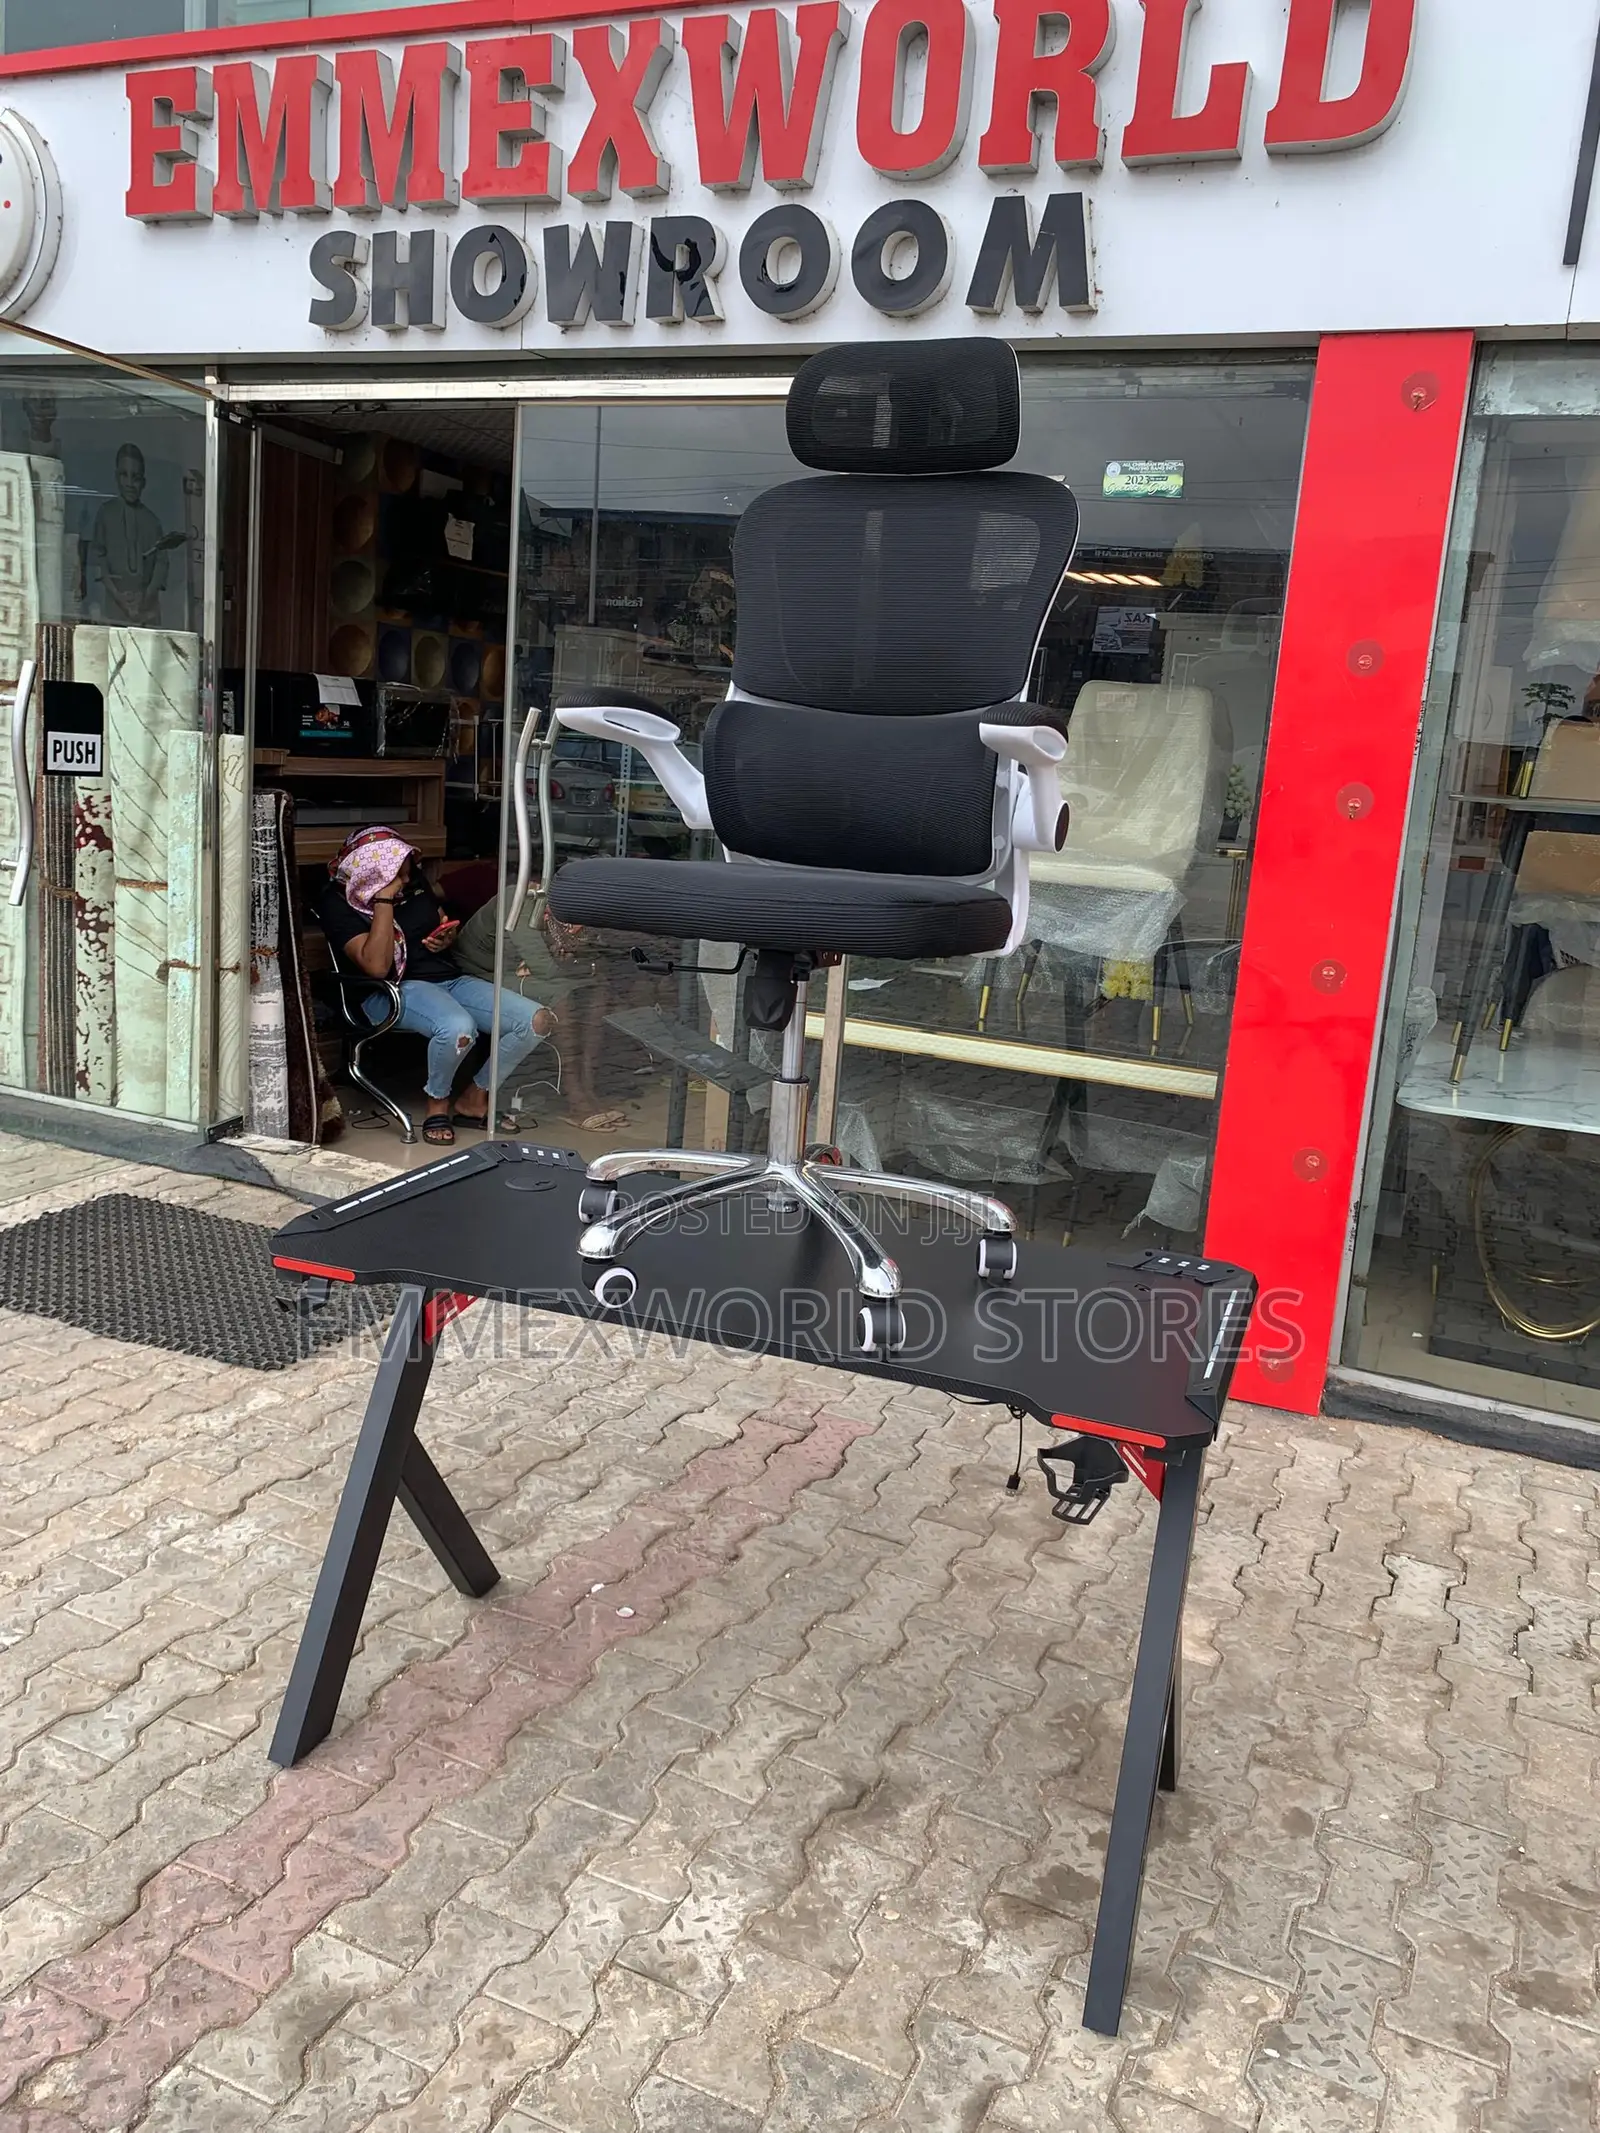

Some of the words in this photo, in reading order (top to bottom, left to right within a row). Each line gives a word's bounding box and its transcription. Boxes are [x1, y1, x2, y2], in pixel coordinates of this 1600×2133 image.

[126, 0, 1415, 221] EMMEXWORLD
[309, 192, 1096, 330] SHOWROOM
[1125, 475, 1150, 485] 2023
[53, 739, 96, 765] PUSH
